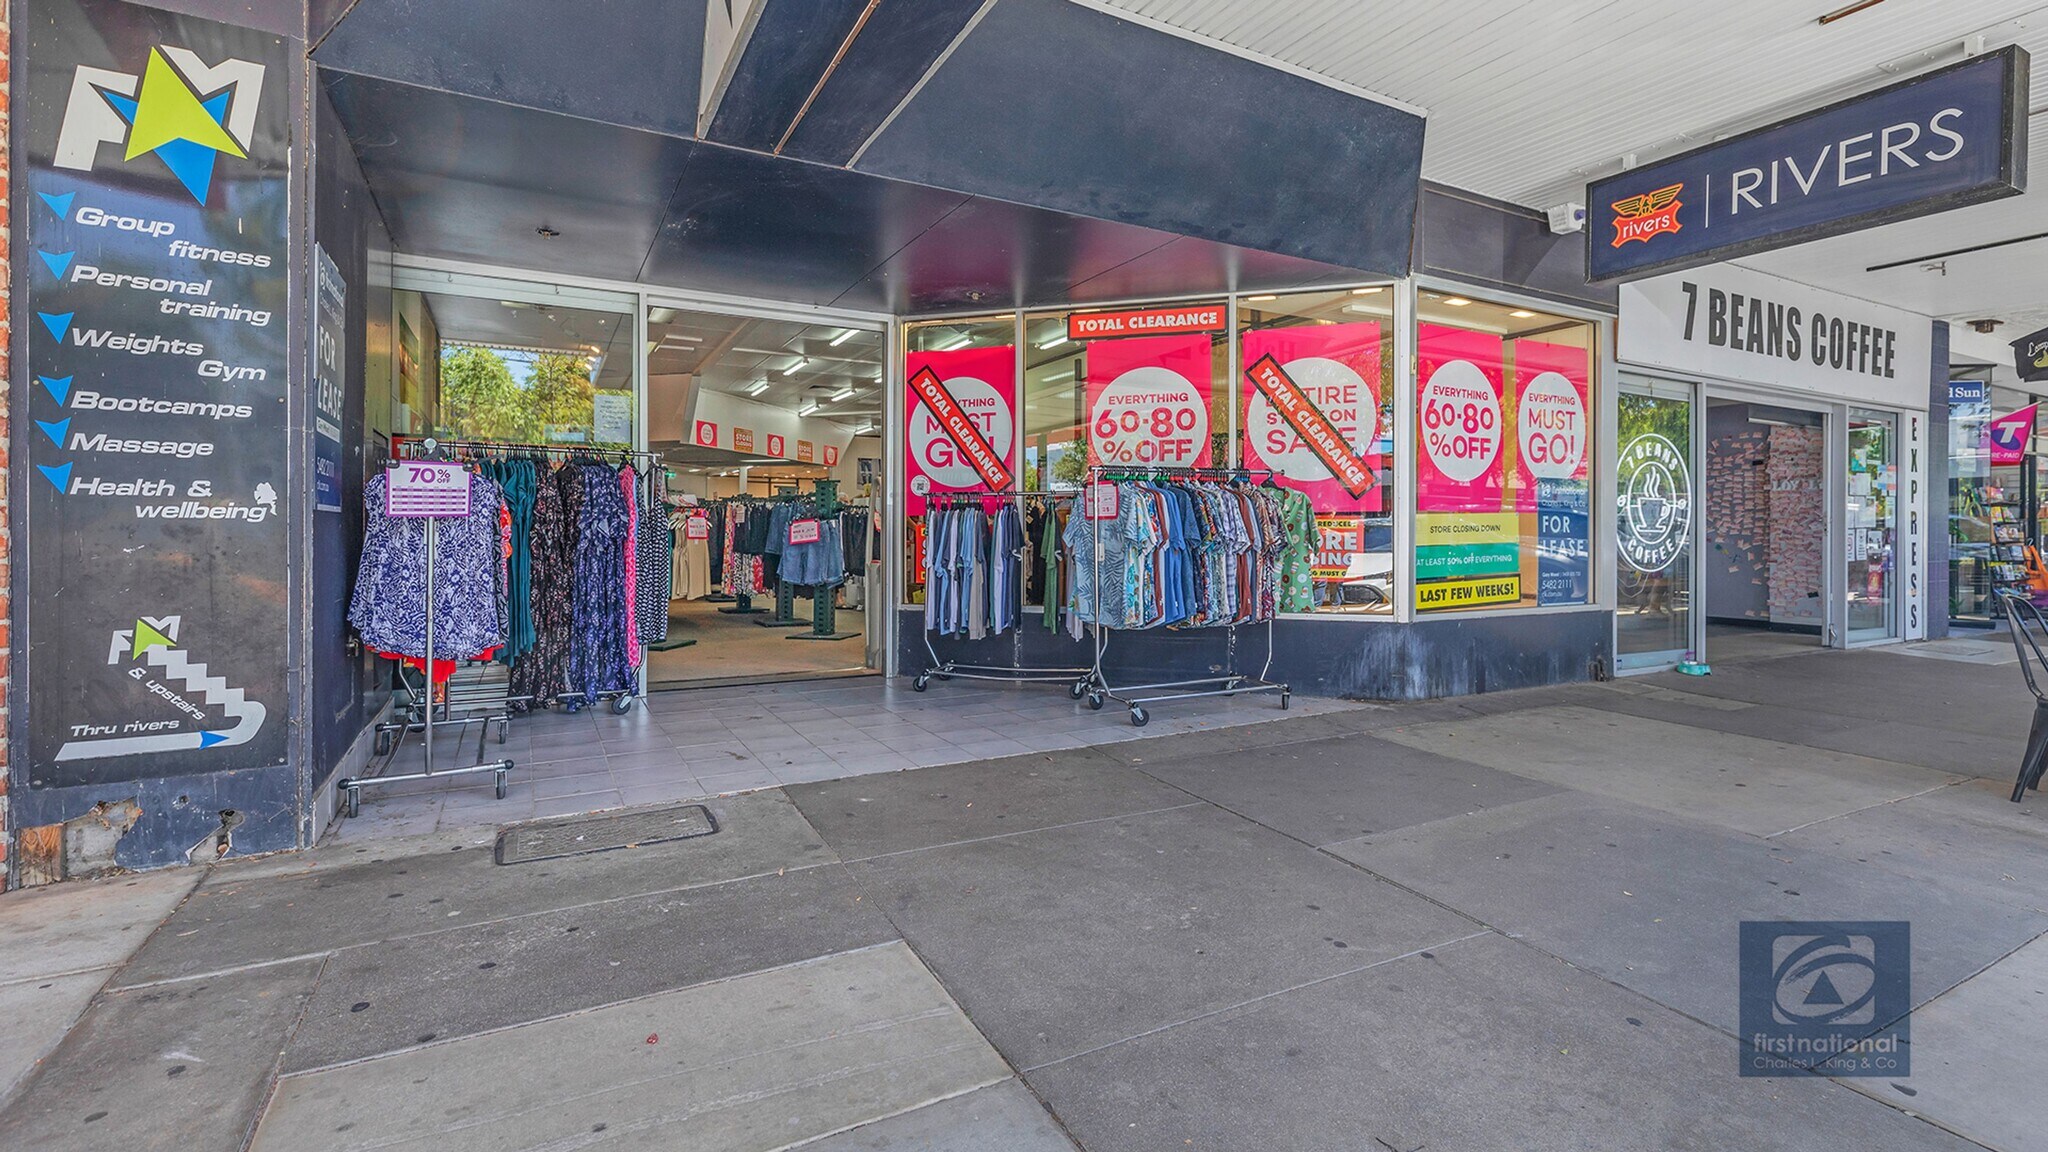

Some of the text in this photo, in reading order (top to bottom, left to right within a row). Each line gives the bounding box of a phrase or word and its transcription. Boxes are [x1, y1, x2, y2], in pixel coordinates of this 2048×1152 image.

[1731, 107, 1965, 216] RIVERS
[75, 206, 175, 238] Group
[1623, 214, 1670, 238] rivers
[169, 240, 272, 268] fitness
[71, 264, 212, 296] Personal
[160, 299, 271, 327] training
[1078, 312, 1217, 332] TOTAL CLEARANCE
[72, 327, 204, 356] Weights
[1682, 281, 1896, 378] 7 BEANS COFFEE
[319, 325, 336, 372] FOR
[198, 360, 266, 381] Gym
[317, 381, 342, 421] LEASE
[1108, 392, 1189, 405] EVERYTHING
[1433, 385, 1488, 401] EVERYTHING
[1529, 393, 1575, 406] EVERYTHING
[1955, 387, 1980, 398] Sun
[71, 391, 253, 420] Bootcamps
[1329, 409, 1357, 422] ON
[920, 377, 952, 418] TOTAL
[949, 416, 1003, 484] CLEARANCE
[926, 412, 996, 434] MST
[1261, 367, 1299, 412] TOTAL
[1297, 410, 1365, 485] CLEARANCE
[1528, 408, 1576, 431] MUST
[70, 433, 214, 458] Massage
[1528, 432, 1574, 465] GO!
[1626, 442, 1678, 471] 7 BEANS
[70, 477, 213, 497] Health &
[135, 501, 267, 522] wellbeing
[1910, 416, 1918, 629] EXPRESS
[1430, 525, 1451, 533] STORE
[1453, 525, 1479, 533] CLOSING
[1542, 515, 1570, 533] FOR
[1425, 558, 1446, 566] LEAST
[1447, 557, 1462, 565] 50%
[1464, 555, 1474, 564] OFF
[1475, 554, 1512, 564] EVERYTHING
[1542, 540, 1584, 557] LEASE
[1627, 537, 1675, 564] COFFEE
[1420, 582, 1514, 602] LAST FEW WEEKS!
[1558, 580, 1571, 589] 2111
[128, 667, 205, 721] & upstairs
[71, 719, 180, 737] Thru rivers
